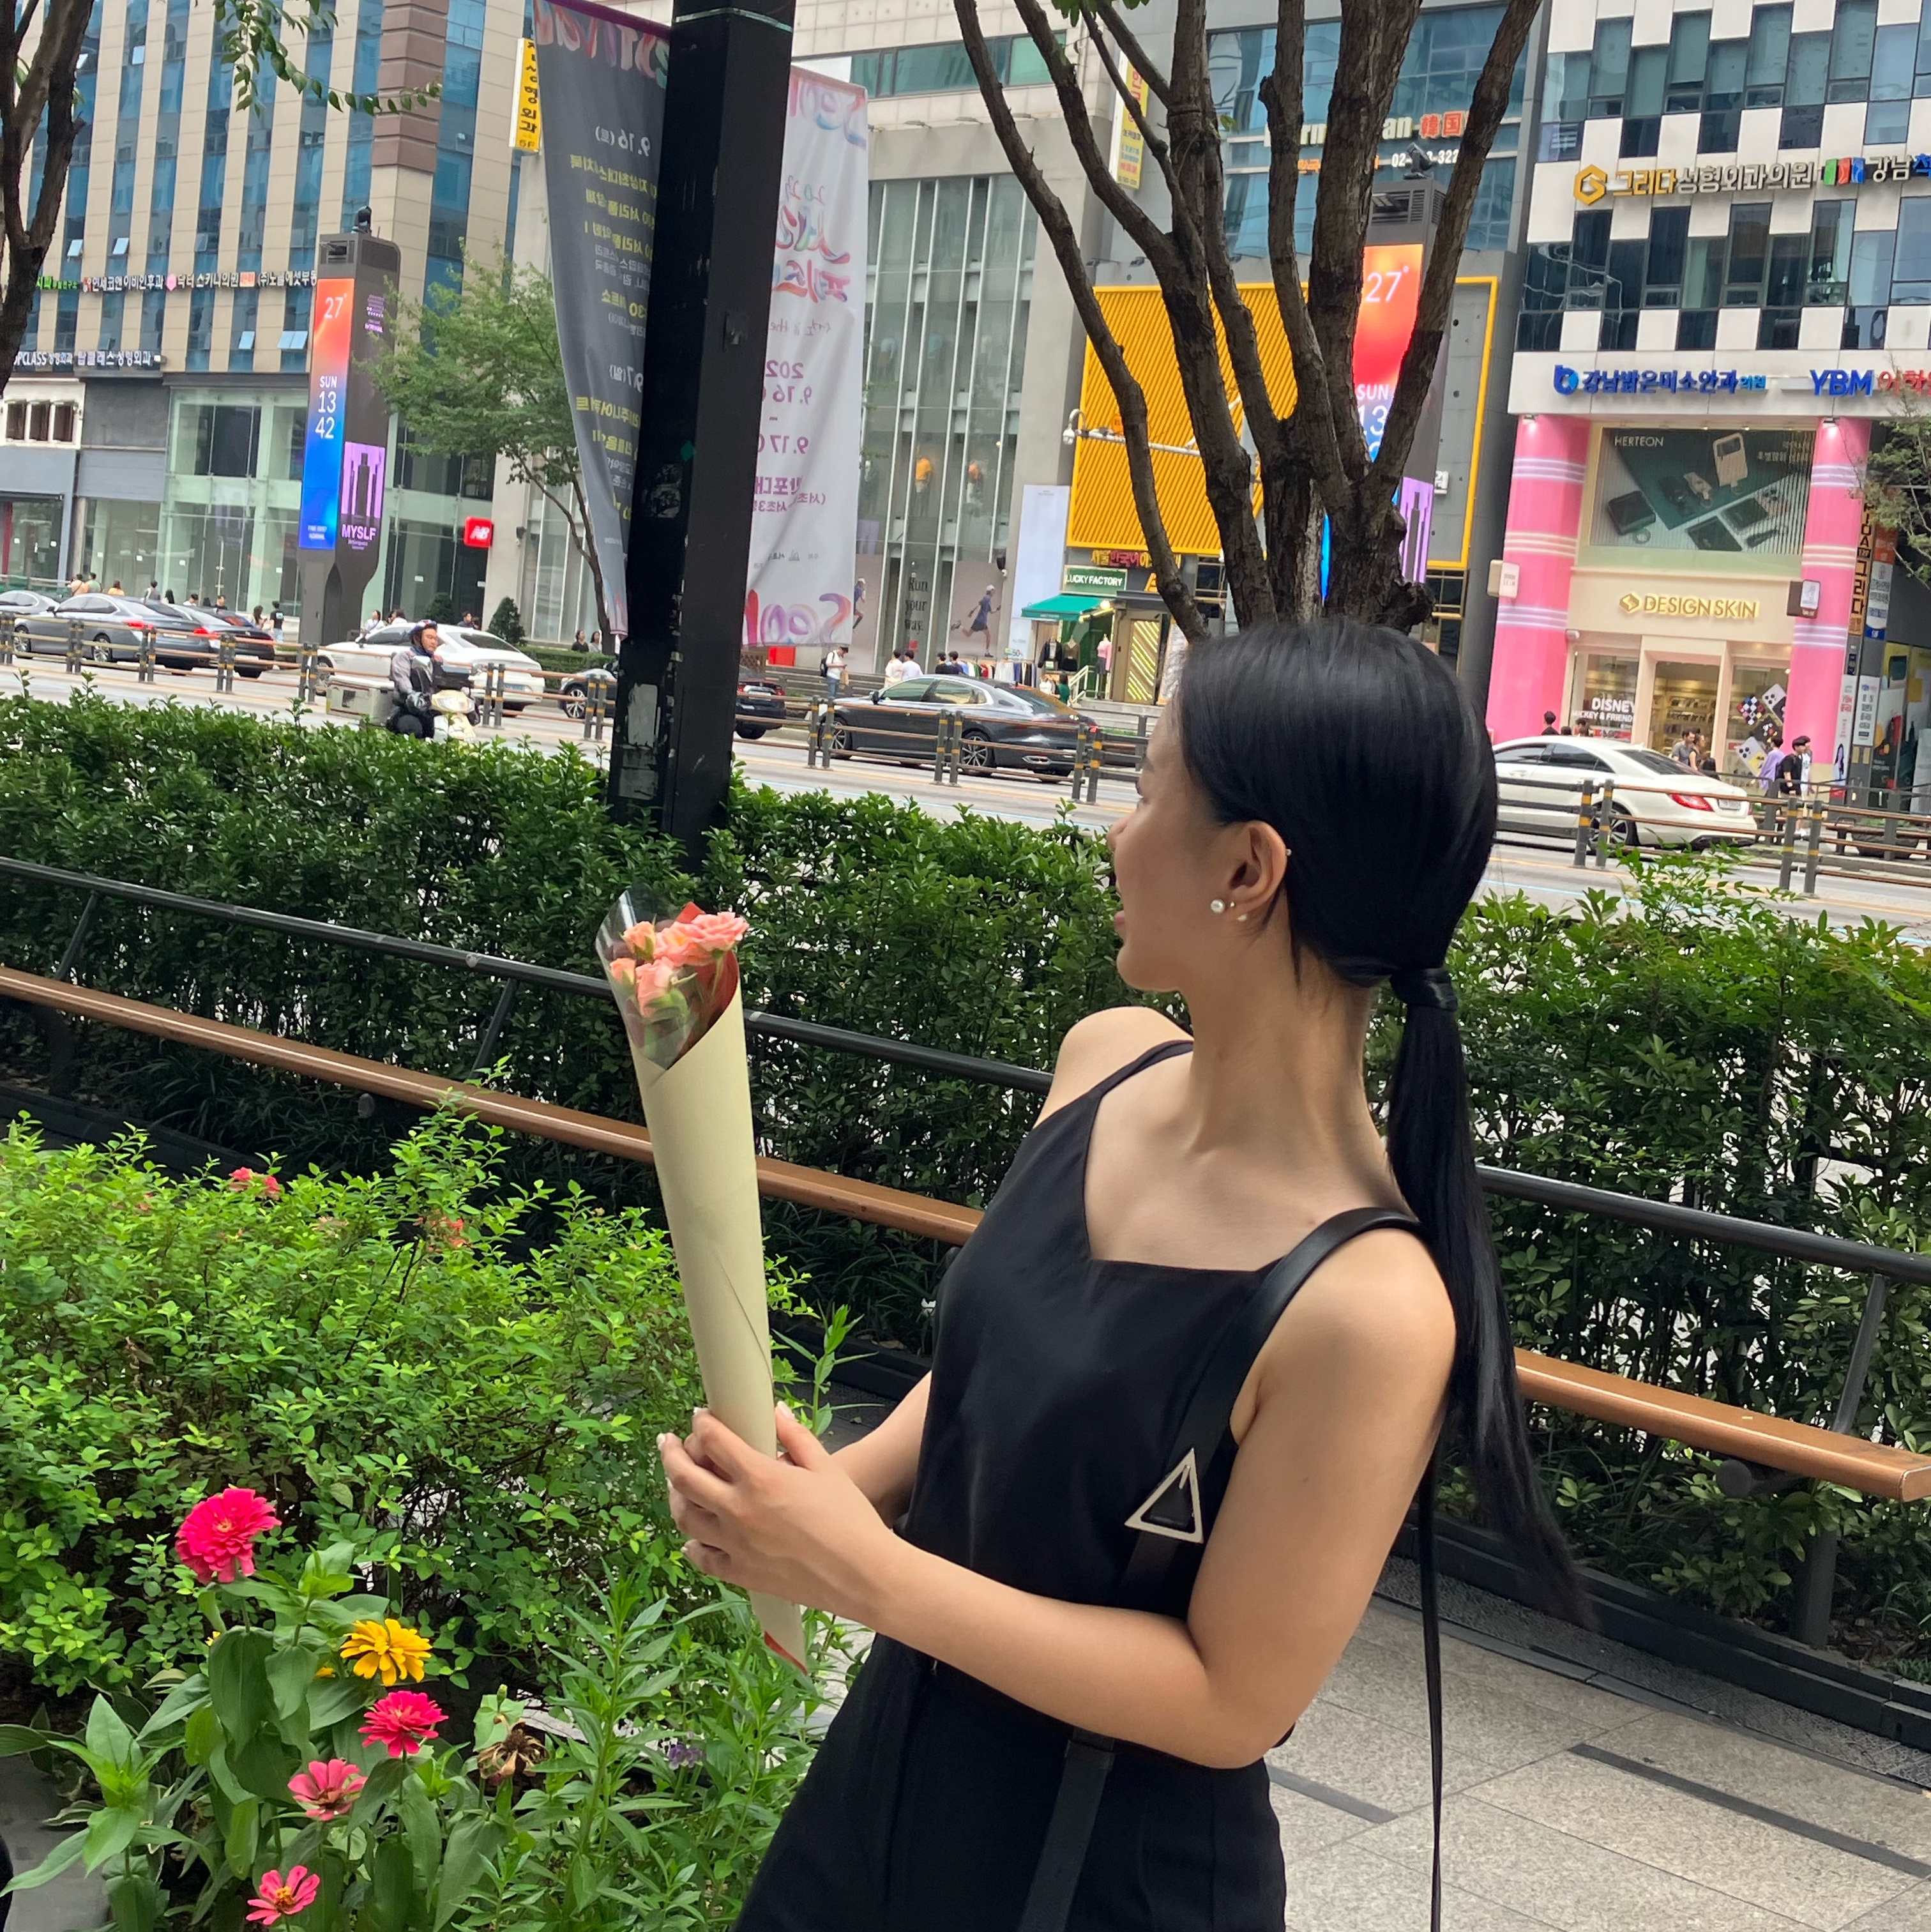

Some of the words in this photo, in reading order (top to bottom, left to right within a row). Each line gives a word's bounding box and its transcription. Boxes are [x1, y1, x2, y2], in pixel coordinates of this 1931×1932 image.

[320, 375, 338, 388] SUN
[1809, 369, 1875, 397] YBM
[1356, 384, 1390, 400] SUN
[318, 390, 337, 413] 13
[315, 416, 335, 439] 42
[342, 524, 377, 540] MYSLF
[1088, 575, 1123, 587] FACTORY
[1606, 712, 1633, 723] FRIEND
